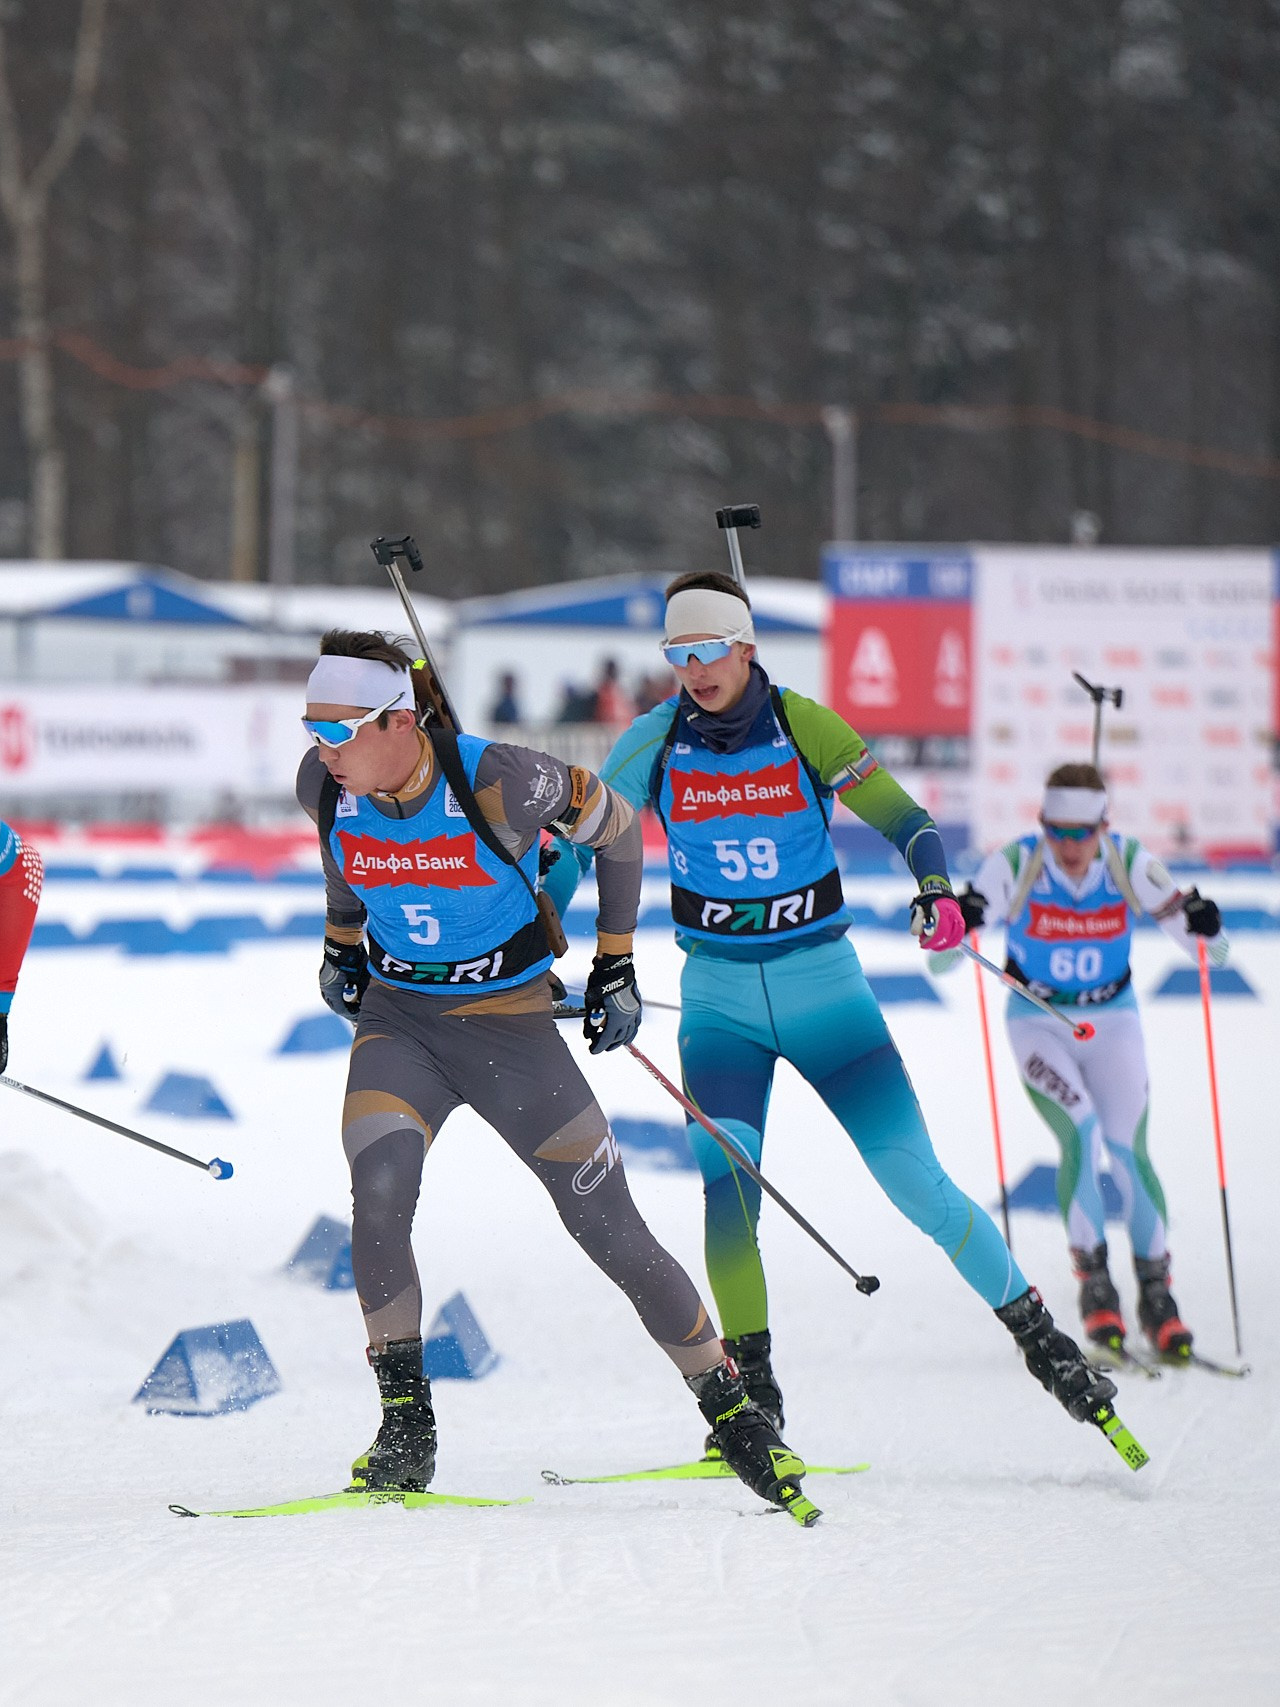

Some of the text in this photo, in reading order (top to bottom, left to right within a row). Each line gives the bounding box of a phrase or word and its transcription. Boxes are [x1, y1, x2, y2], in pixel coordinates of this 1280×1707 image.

[684, 784, 793, 806] Альфа Банк
[352, 851, 469, 875] Альфа Банк
[713, 837, 780, 881] 59
[400, 904, 440, 945] 5
[701, 888, 815, 931] PARI
[381, 950, 504, 983] PARI
[1049, 947, 1104, 982] 60
[601, 977, 625, 994] SWIX
